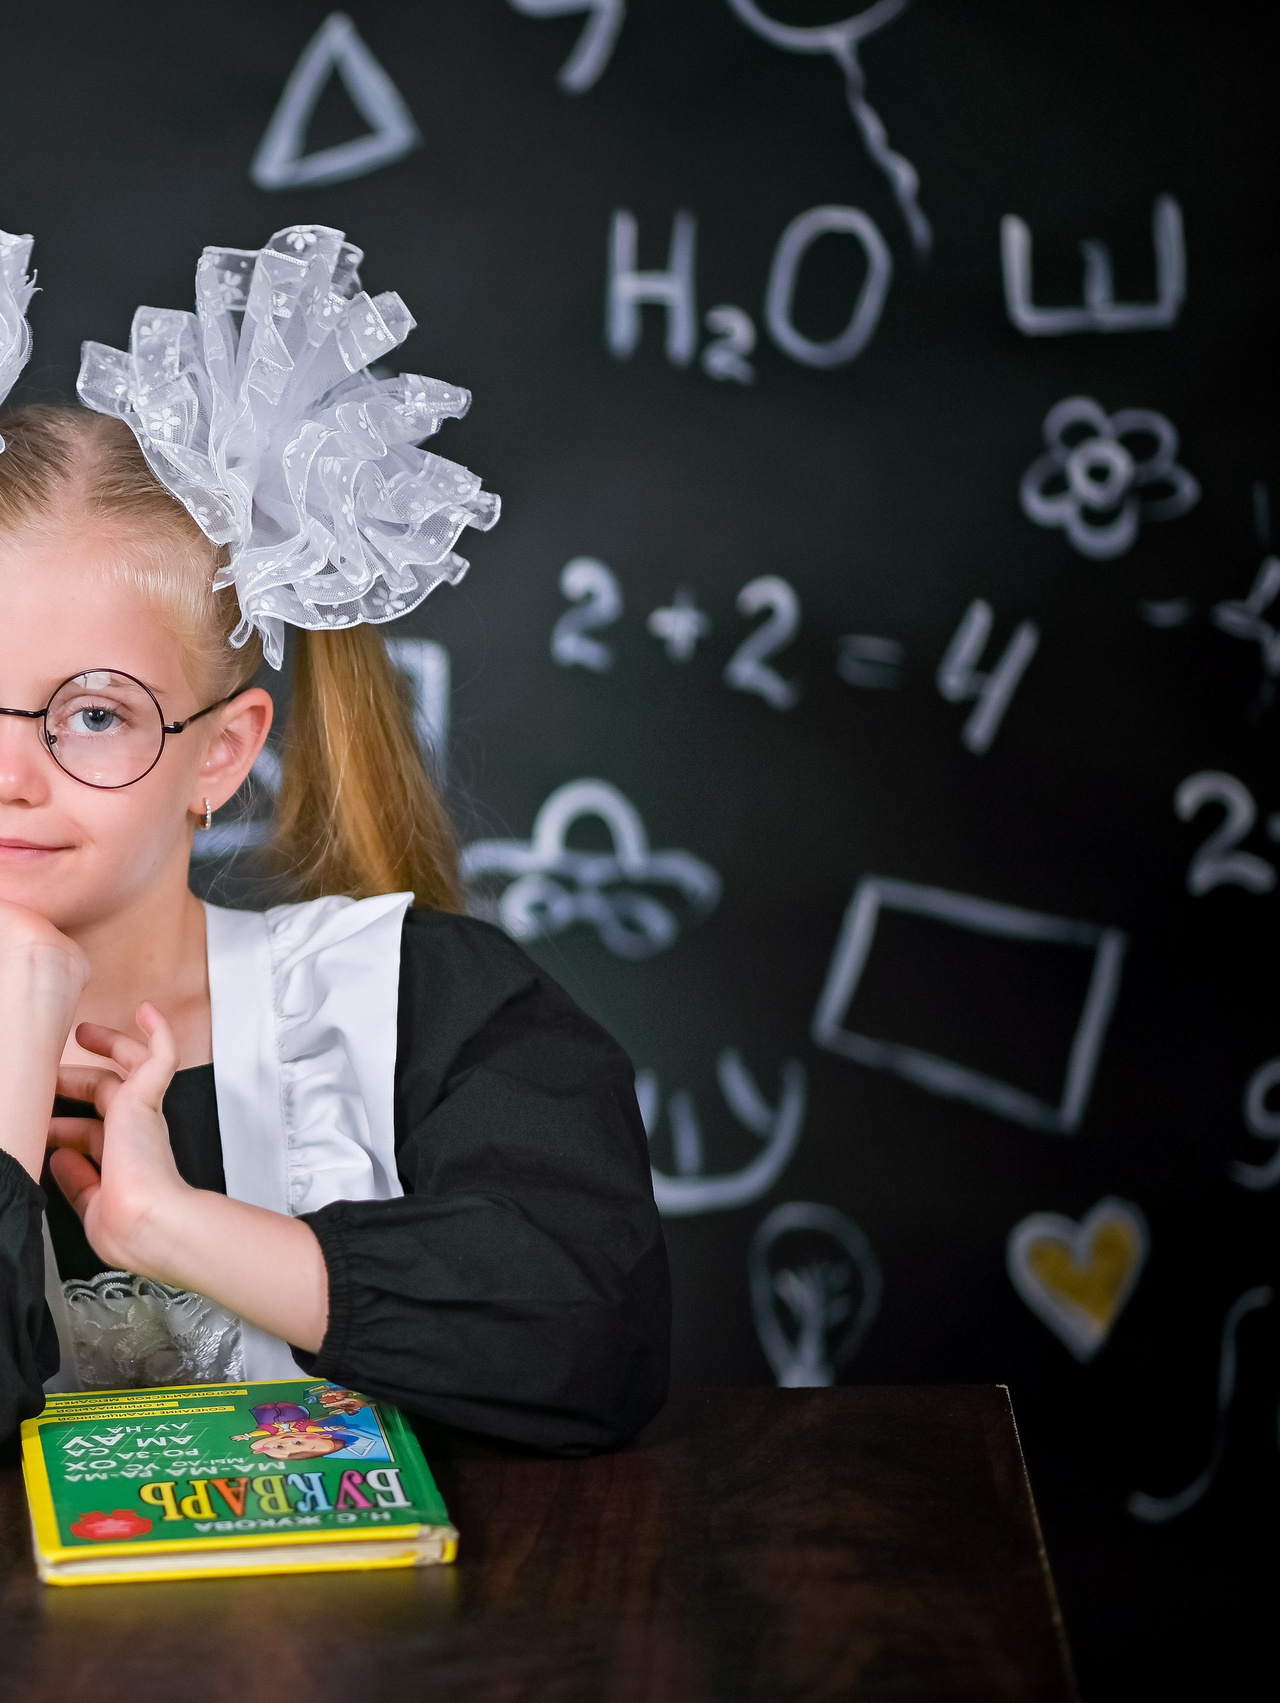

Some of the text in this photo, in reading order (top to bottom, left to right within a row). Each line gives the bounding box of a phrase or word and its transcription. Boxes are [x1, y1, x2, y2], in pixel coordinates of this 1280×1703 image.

[55, 1390, 239, 1406] ЛОГОПЕДИЧЕСКОЙ МЕТОДИКИ
[56, 1404, 152, 1413] ОРИГИНАЛЬНОЙ
[58, 1406, 226, 1422] СОЧЕТАНИЕ ТРАДИЦИОННОЙ
[62, 1433, 193, 1449] АМ АУ
[66, 1447, 199, 1459] РО-ЗА СА
[63, 1460, 117, 1471] ОХ
[63, 1461, 286, 1482] МА-МА РА-МА
[139, 1467, 412, 1521] БУКВАРЬ
[193, 1513, 322, 1532] ЖУКОВА
